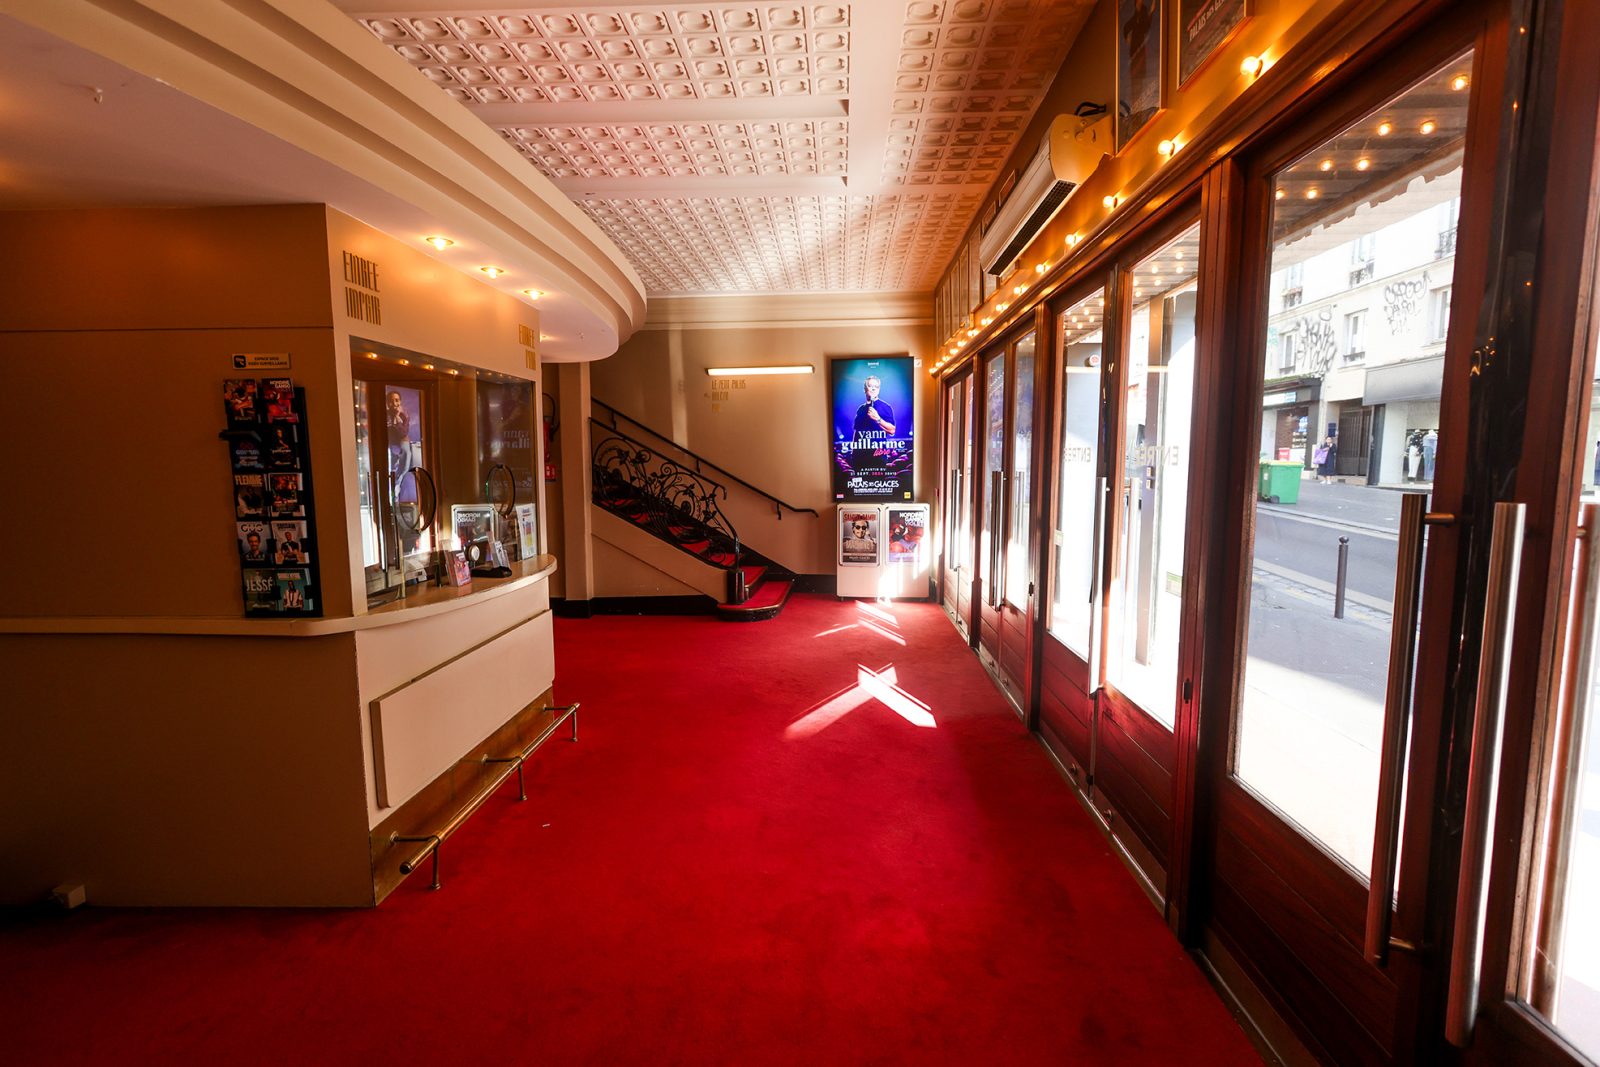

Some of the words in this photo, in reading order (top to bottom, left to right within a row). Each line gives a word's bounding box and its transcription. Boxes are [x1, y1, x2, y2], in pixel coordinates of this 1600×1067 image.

[342, 249, 381, 293] ENTREE
[344, 286, 382, 327] IMPAIR
[711, 379, 717, 390] LE
[858, 430, 887, 439] yann
[841, 438, 906, 454] guillarme
[847, 480, 869, 488] PALAIS
[874, 480, 900, 488] GLACES
